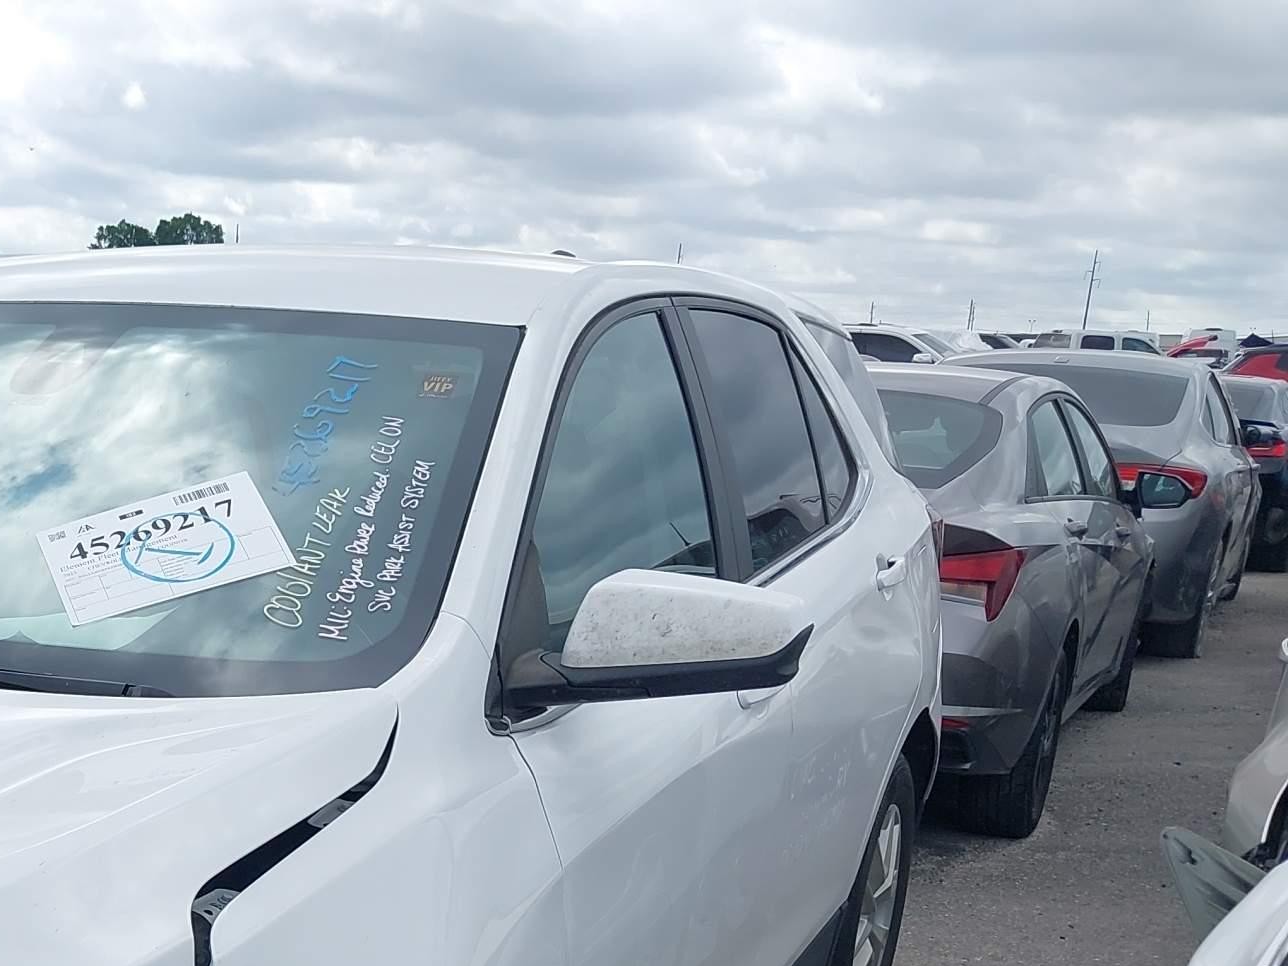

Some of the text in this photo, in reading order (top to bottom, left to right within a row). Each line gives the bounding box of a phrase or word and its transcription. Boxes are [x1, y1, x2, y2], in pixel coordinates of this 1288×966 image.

[423, 381, 453, 393] VIP
[69, 498, 233, 560] 45269217
[312, 486, 351, 535] LEAK
[326, 555, 375, 604] Engine
[378, 415, 405, 437] ON
[367, 458, 437, 613] SVC PARK ASSIST SYSTEM
